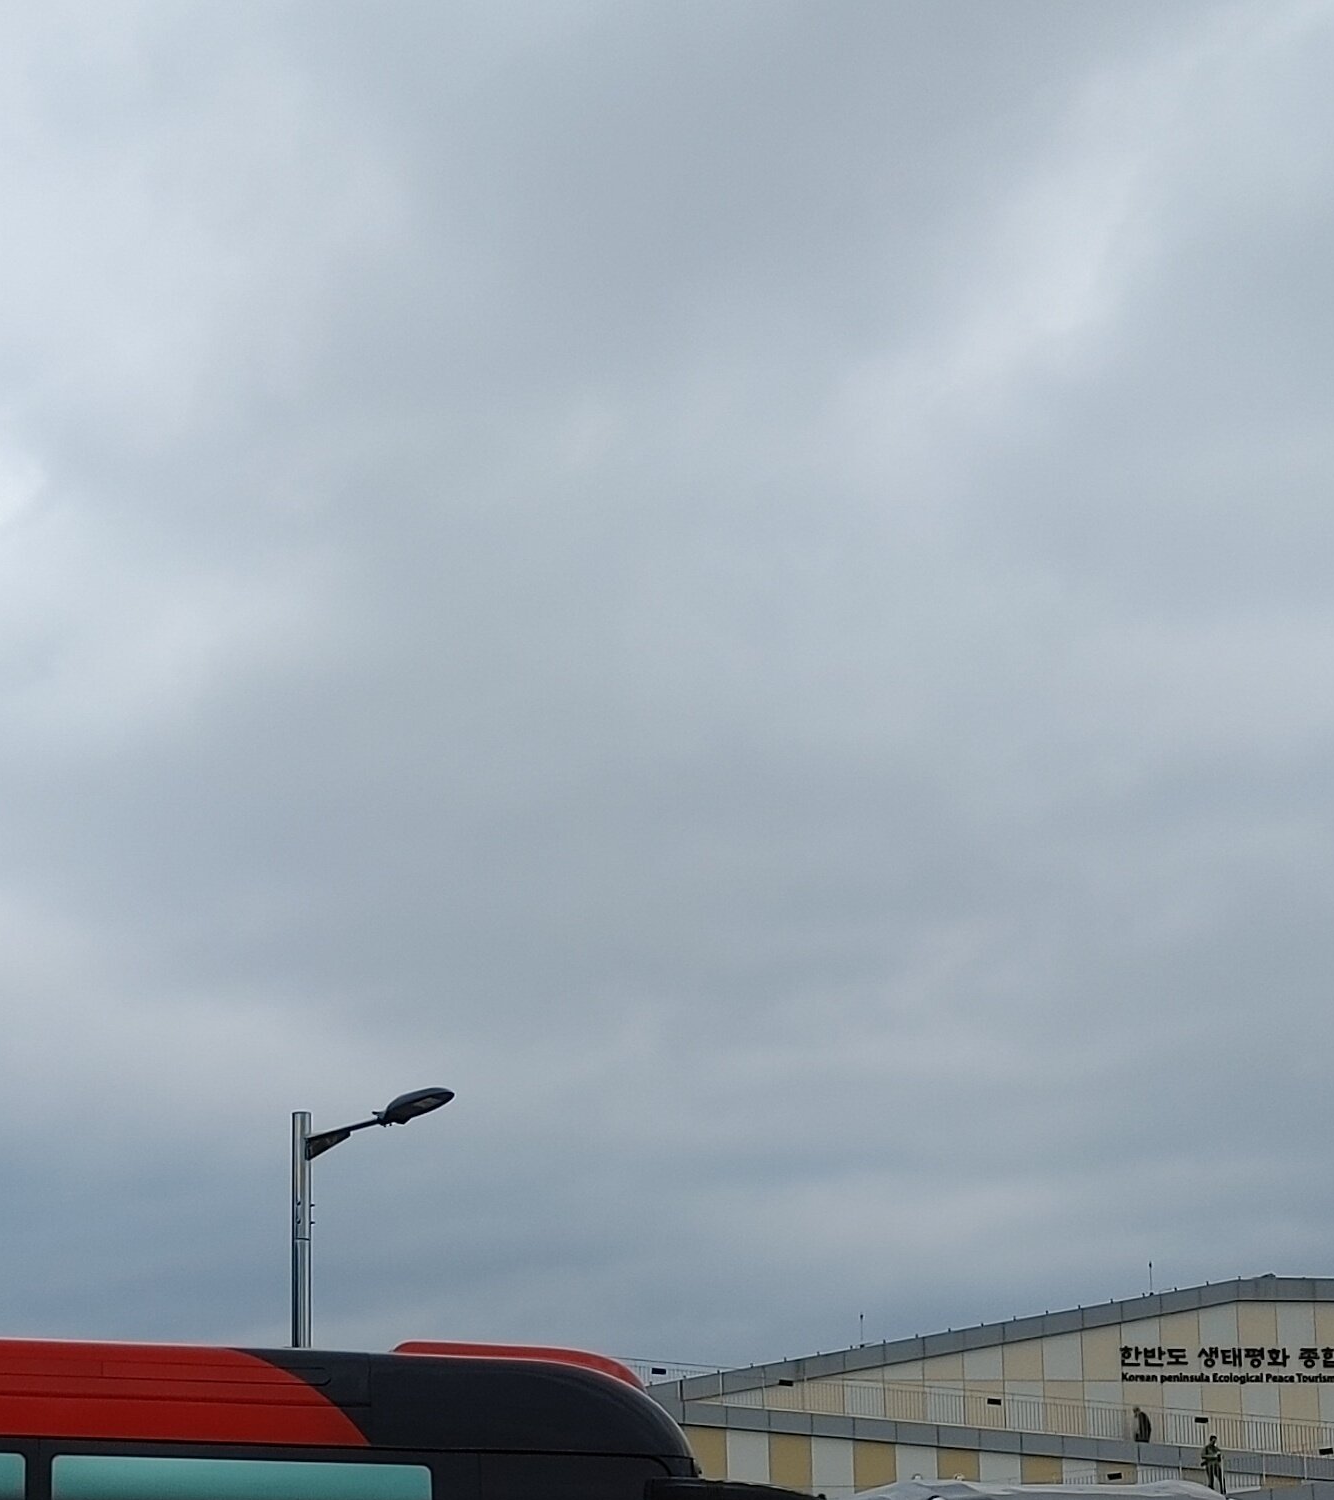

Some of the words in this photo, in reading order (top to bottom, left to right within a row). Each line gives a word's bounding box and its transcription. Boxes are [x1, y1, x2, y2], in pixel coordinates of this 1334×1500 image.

[1119, 1346, 1188, 1367] 한반도
[1197, 1346, 1290, 1368] 생태평화
[1121, 1372, 1158, 1383] Korean
[1160, 1372, 1211, 1385] peninsula
[1212, 1372, 1264, 1385] Ecological
[1265, 1373, 1295, 1383] Peace
